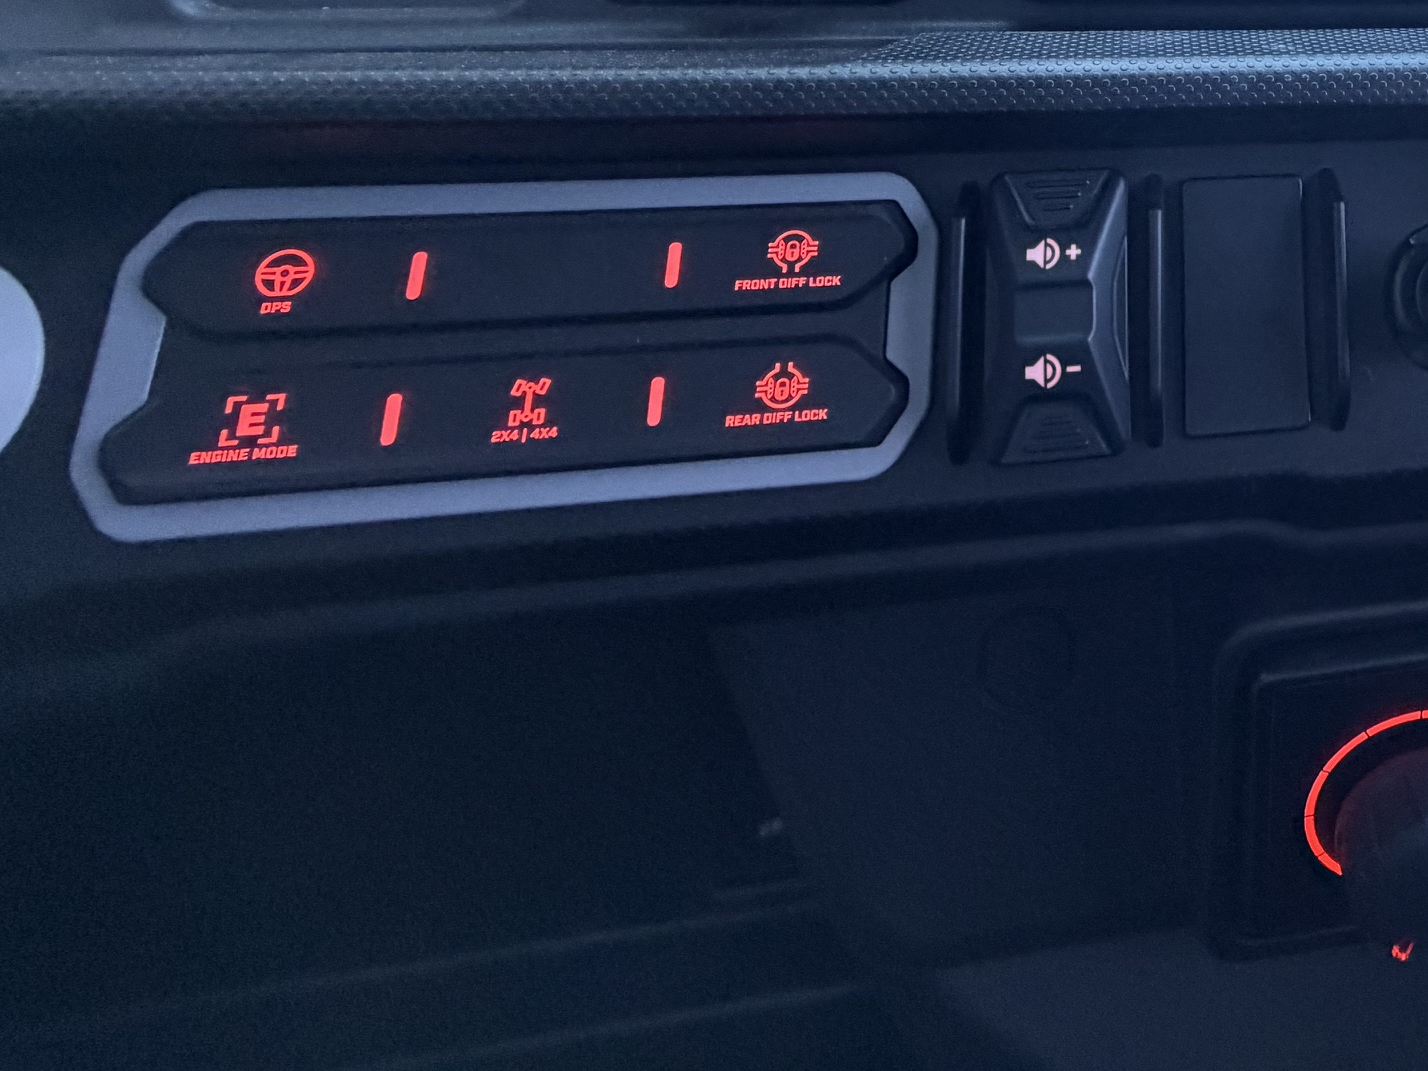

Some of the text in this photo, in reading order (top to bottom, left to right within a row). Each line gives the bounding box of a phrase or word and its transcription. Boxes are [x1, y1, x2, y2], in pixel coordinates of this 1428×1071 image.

[735, 276, 841, 290] FRONT DIFF LOCK
[726, 409, 828, 426] REAR DIFF LOCK
[491, 429, 519, 444] 2X4
[530, 426, 558, 439] 4X4
[188, 445, 298, 465] ENGINE MODE
